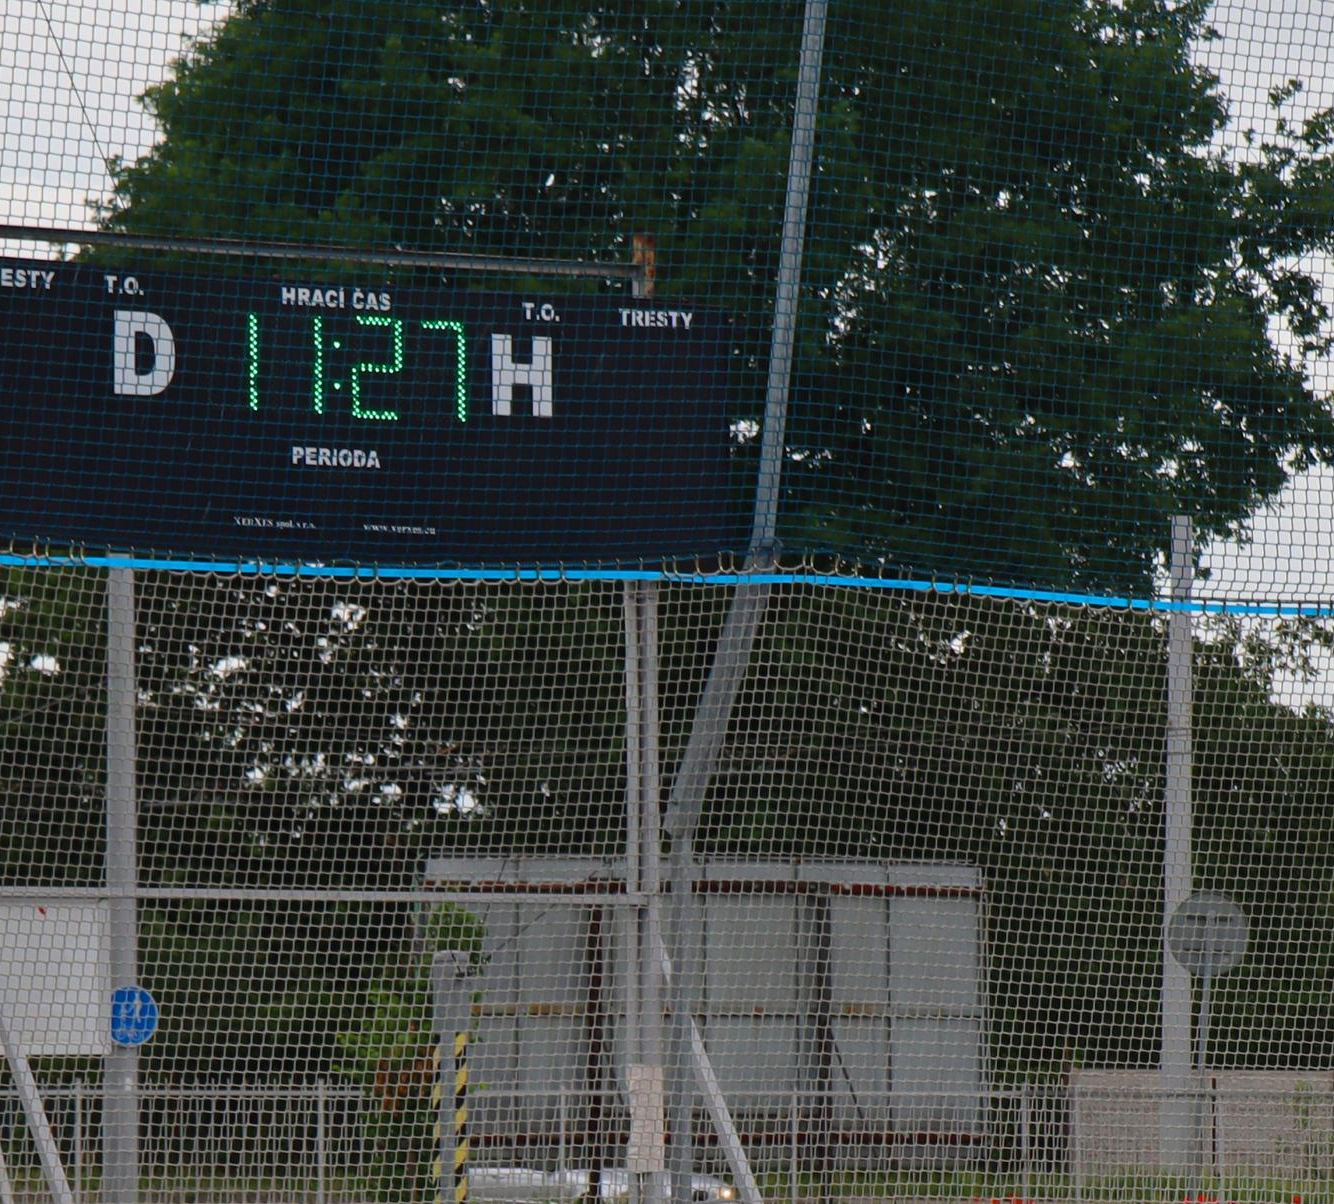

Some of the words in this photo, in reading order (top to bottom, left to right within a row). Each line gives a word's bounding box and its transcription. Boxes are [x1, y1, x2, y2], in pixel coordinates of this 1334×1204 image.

[104, 274, 145, 296] T.O.
[281, 285, 346, 309] HRACÍ
[352, 287, 392, 312] ČAS
[521, 302, 561, 322] T.O.
[618, 306, 693, 330] TRESTY
[113, 309, 176, 396] D
[249, 314, 467, 422] 11:27
[491, 333, 553, 418] H
[292, 446, 381, 469] PERIODA
